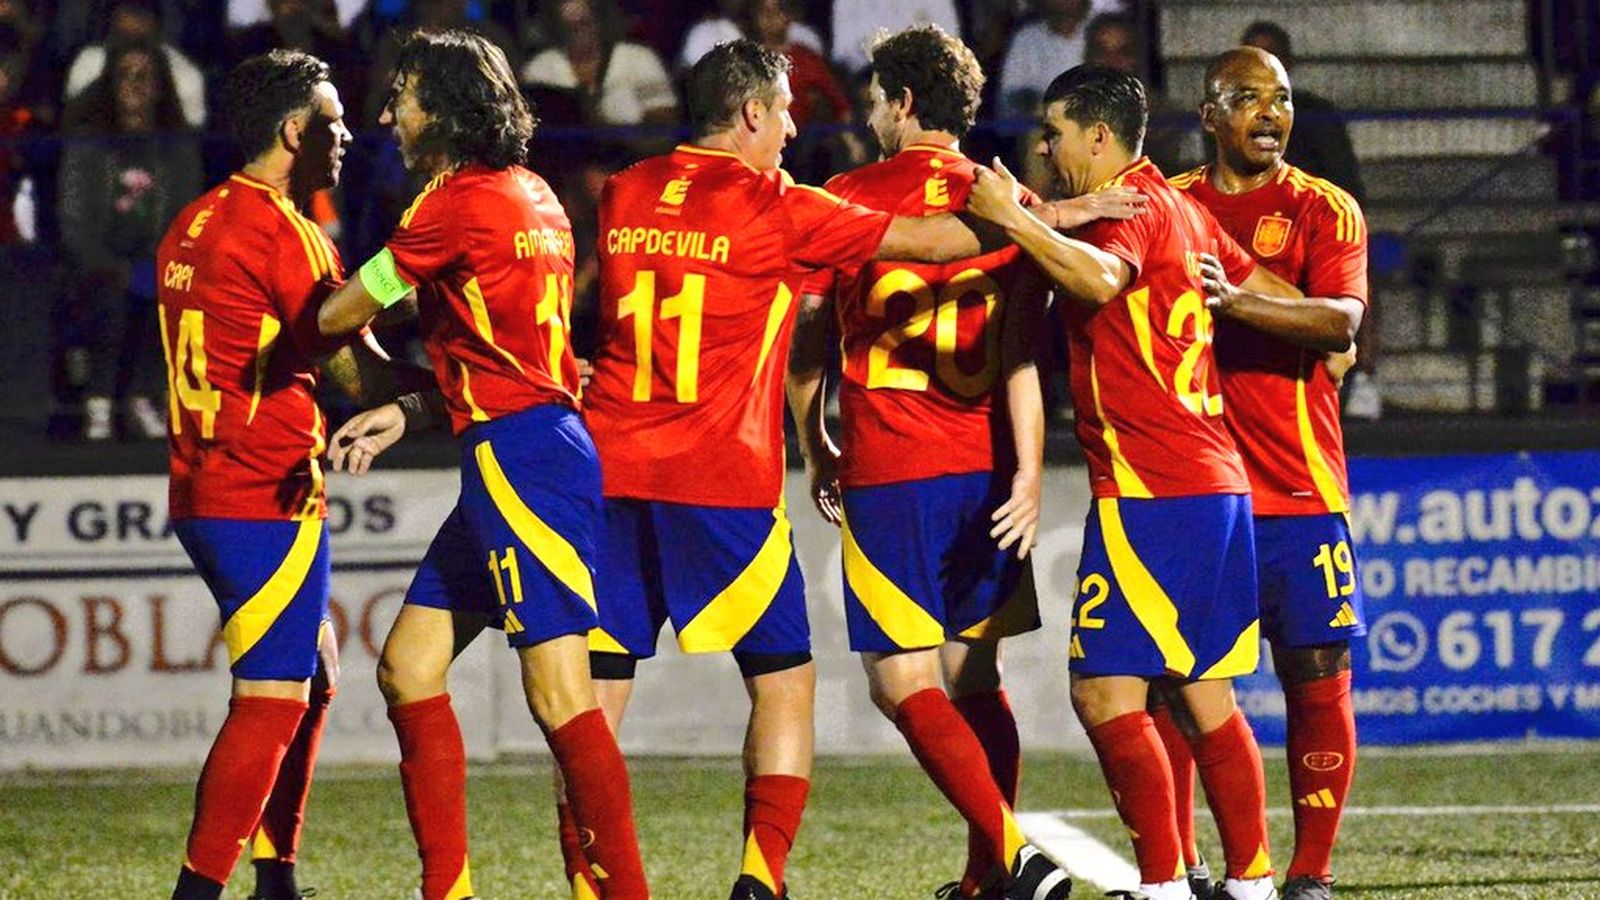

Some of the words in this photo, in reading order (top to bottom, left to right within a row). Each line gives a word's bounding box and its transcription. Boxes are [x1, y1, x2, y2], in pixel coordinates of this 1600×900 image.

[607, 226, 730, 264] CAPDEVILA
[617, 270, 706, 403] 11
[866, 268, 997, 397] 20
[158, 303, 222, 439] 14
[1350, 477, 1600, 544] w.auto
[488, 546, 524, 606] 11
[1072, 572, 1110, 629] 2
[1313, 541, 1356, 599] 19
[1403, 553, 1600, 597] RECAMBI
[1437, 607, 1566, 672] 617
